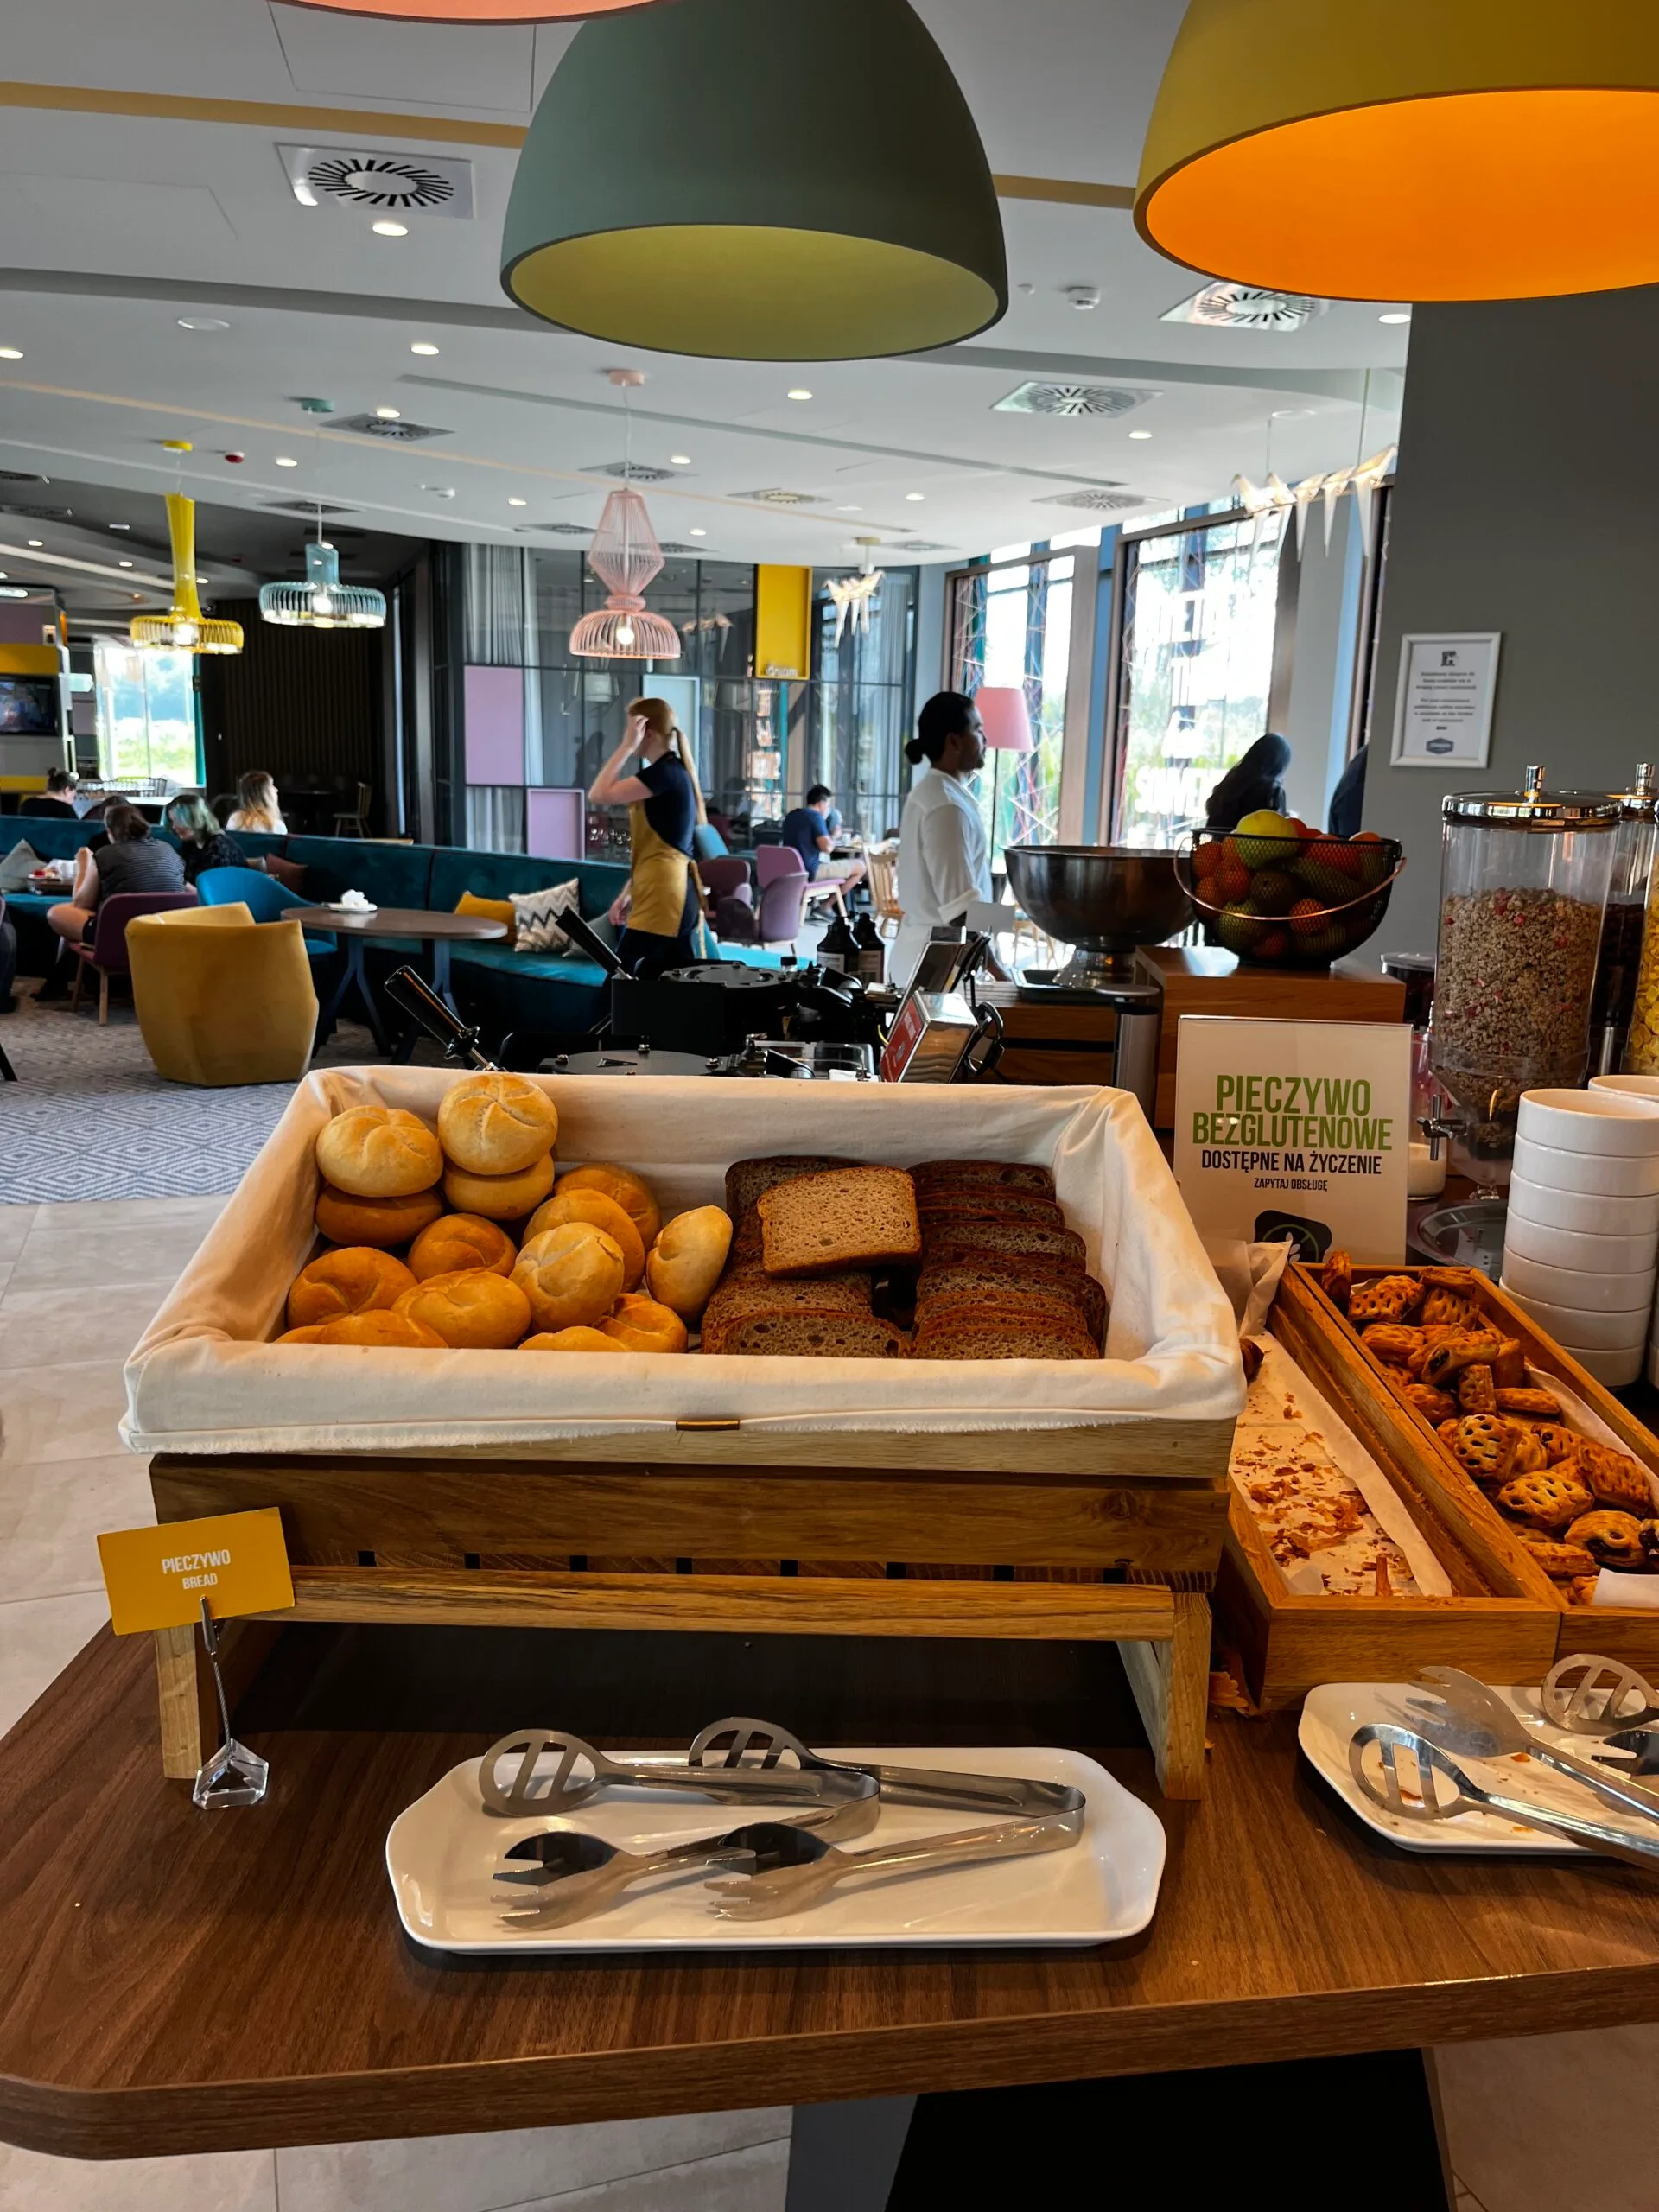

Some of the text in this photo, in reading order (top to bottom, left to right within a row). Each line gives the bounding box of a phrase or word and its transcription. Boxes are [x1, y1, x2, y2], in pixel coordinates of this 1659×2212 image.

[1216, 1075, 1370, 1116] PIECZYWO
[1192, 1112, 1393, 1151] BEZGLUTENOWE
[1202, 1150, 1382, 1175] DOSTĘPNE NA ŻYCZENIE
[1254, 1178, 1328, 1192] ZAPYTAJ OBSŁUGĘ
[162, 1549, 231, 1574] PIECZYWO
[182, 1573, 218, 1589] BREAD
